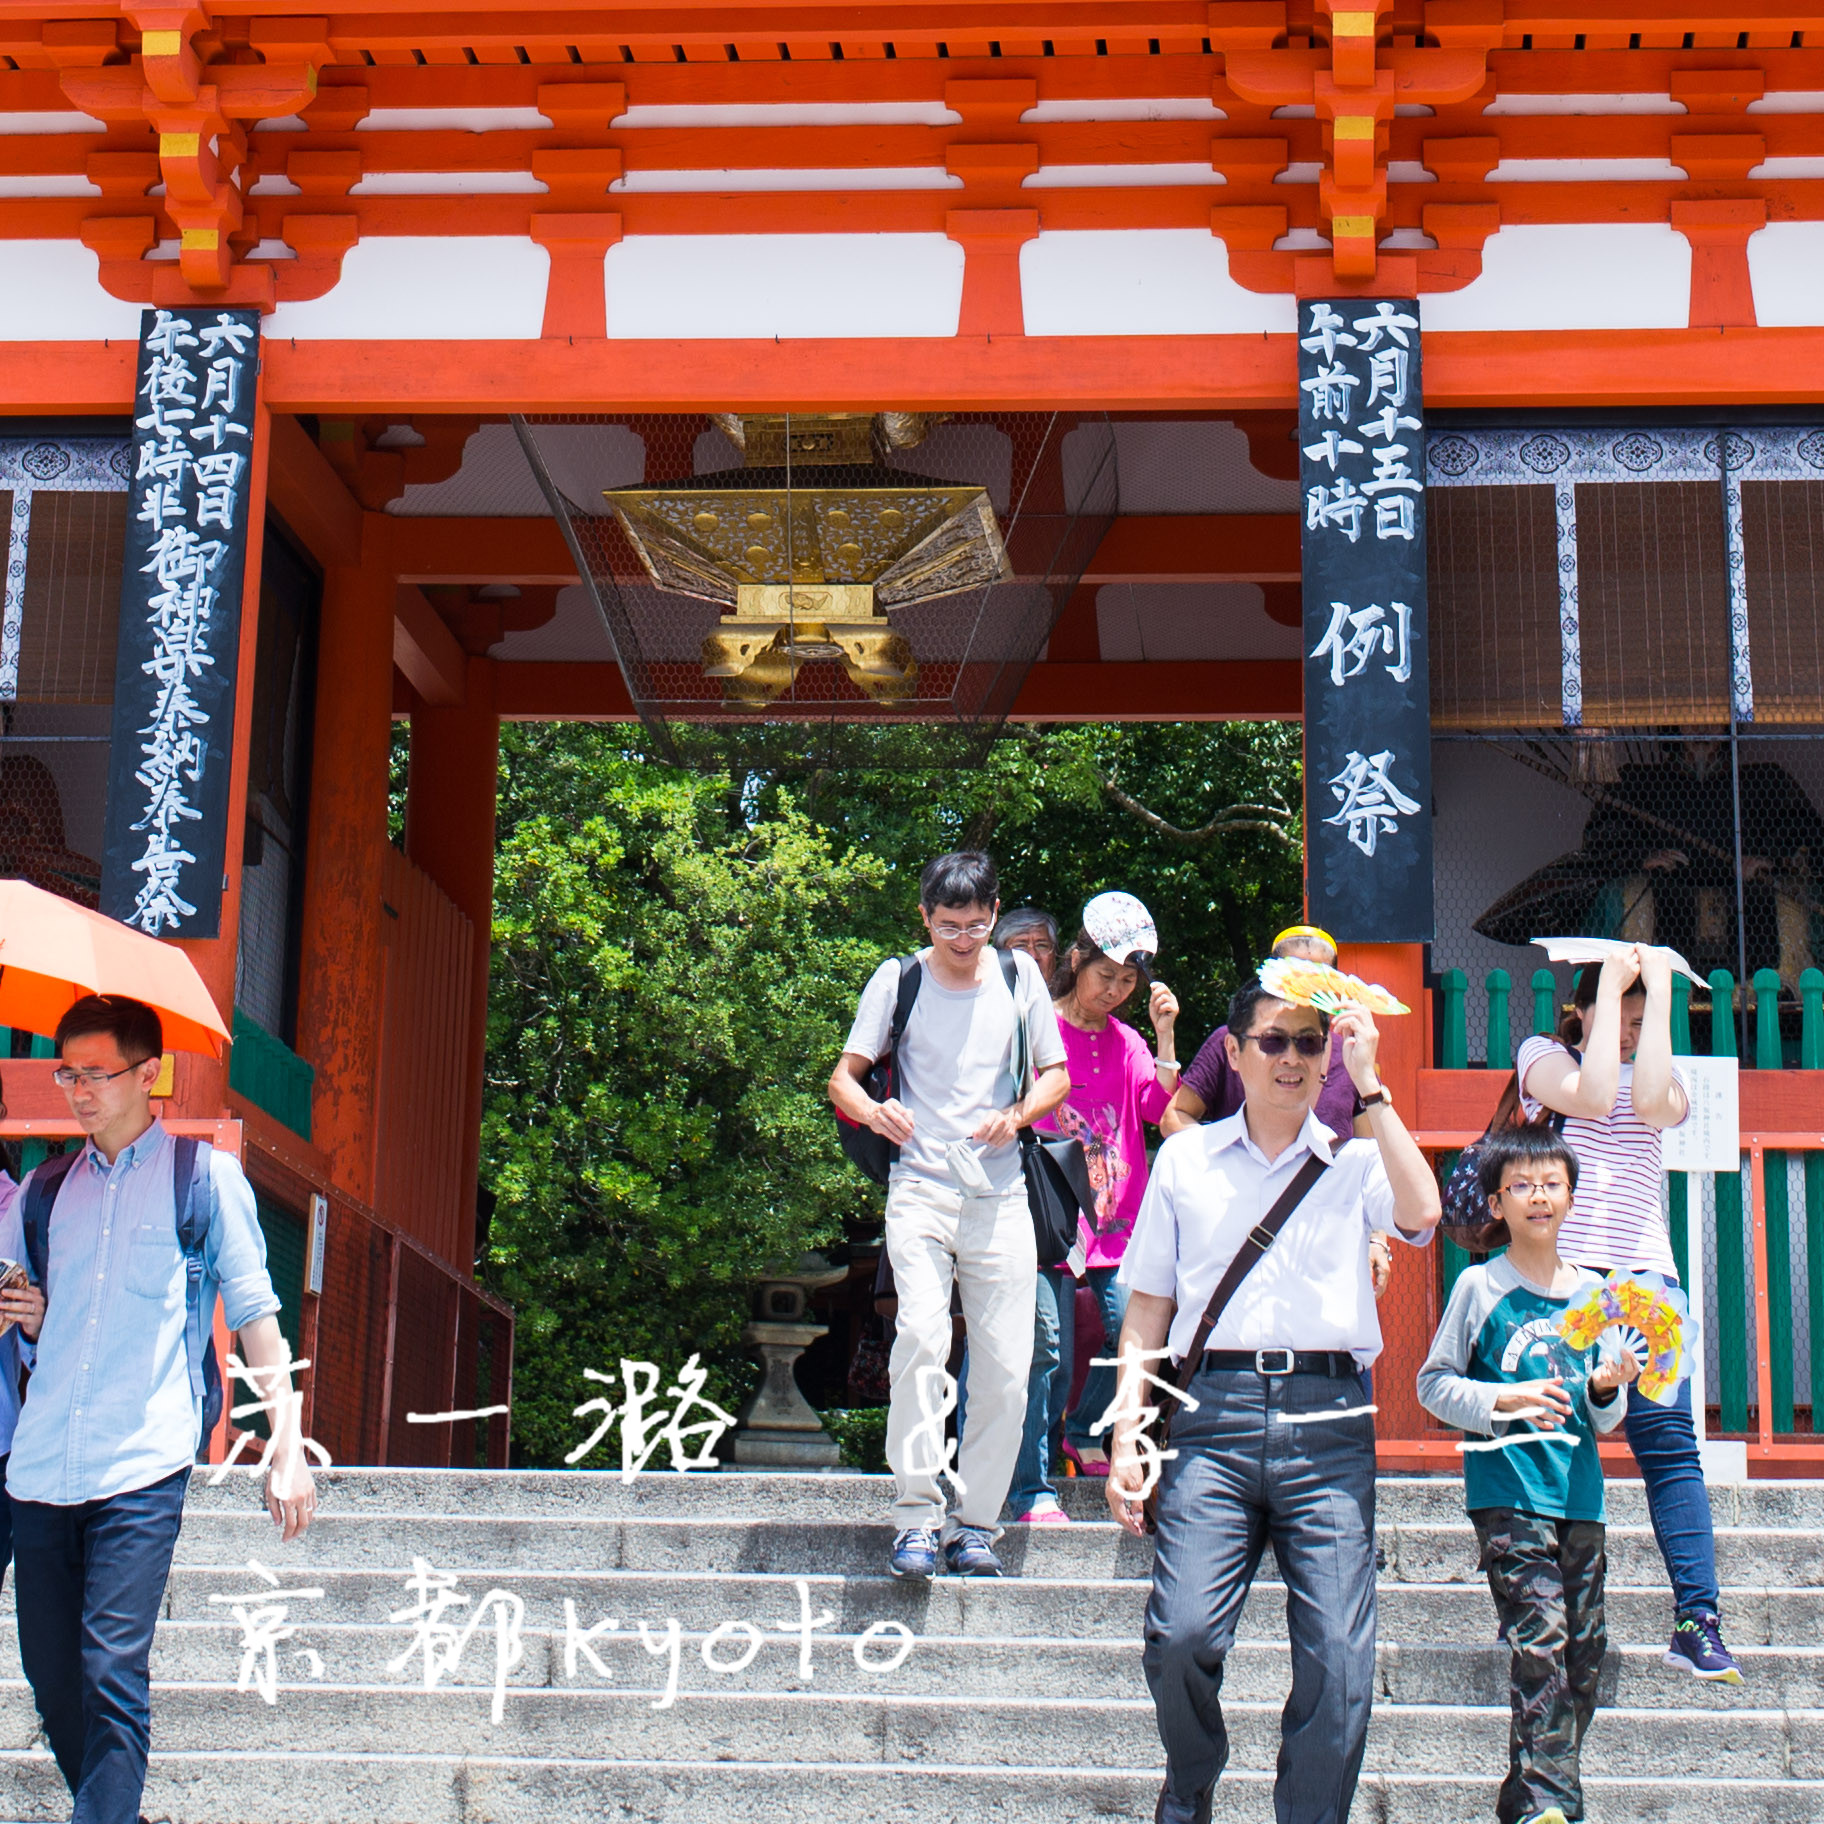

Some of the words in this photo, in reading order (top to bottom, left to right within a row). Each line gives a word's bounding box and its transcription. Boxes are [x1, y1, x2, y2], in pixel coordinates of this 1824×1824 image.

[136, 310, 199, 531] 午後七時半
[190, 313, 254, 530] 六月十四日
[1300, 303, 1368, 544] 午前十時
[1352, 302, 1423, 541] 六月十五日
[1310, 601, 1422, 857] 例祭
